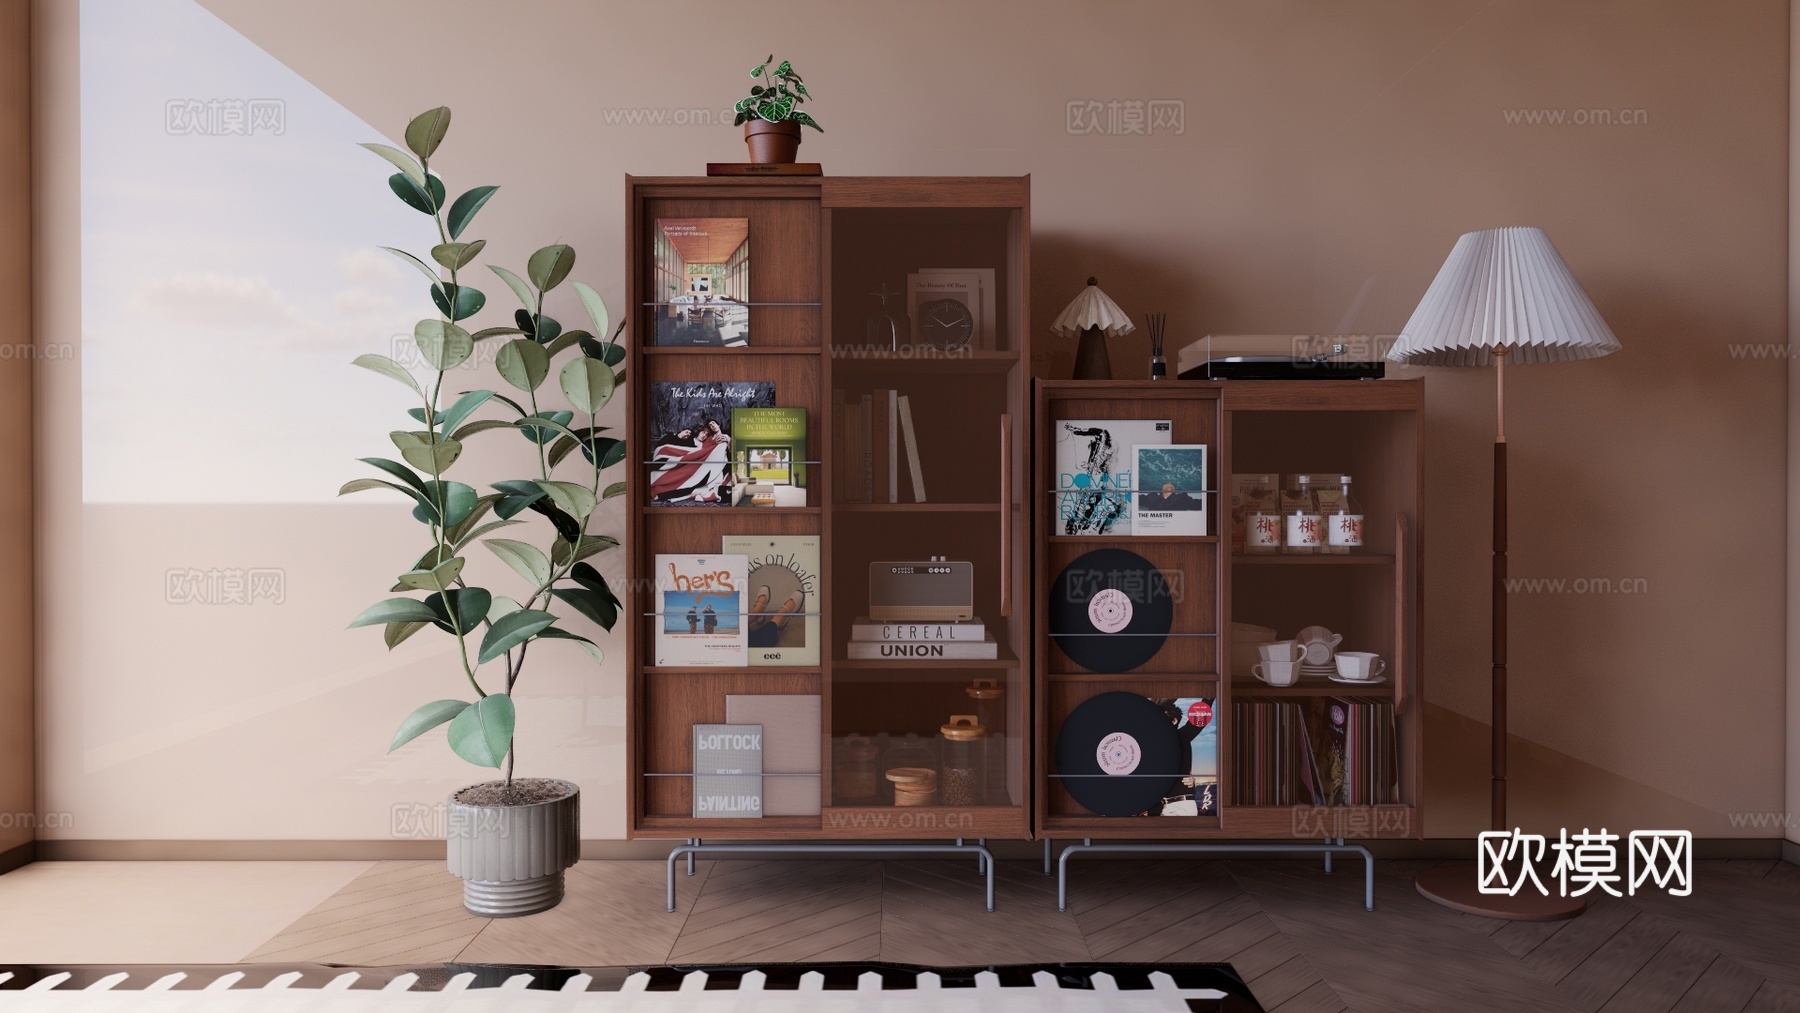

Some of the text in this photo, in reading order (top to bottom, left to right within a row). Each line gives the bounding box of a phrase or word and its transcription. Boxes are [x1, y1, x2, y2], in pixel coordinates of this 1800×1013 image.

[671, 387, 756, 402] The Kids Are Alright
[863, 452, 872, 493] ROADS
[1256, 517, 1274, 533] 桃
[1298, 517, 1316, 533] 桃
[1340, 517, 1357, 533] 桃
[765, 553, 784, 567] on
[883, 625, 955, 639] CEREAL
[880, 645, 944, 657] UNION
